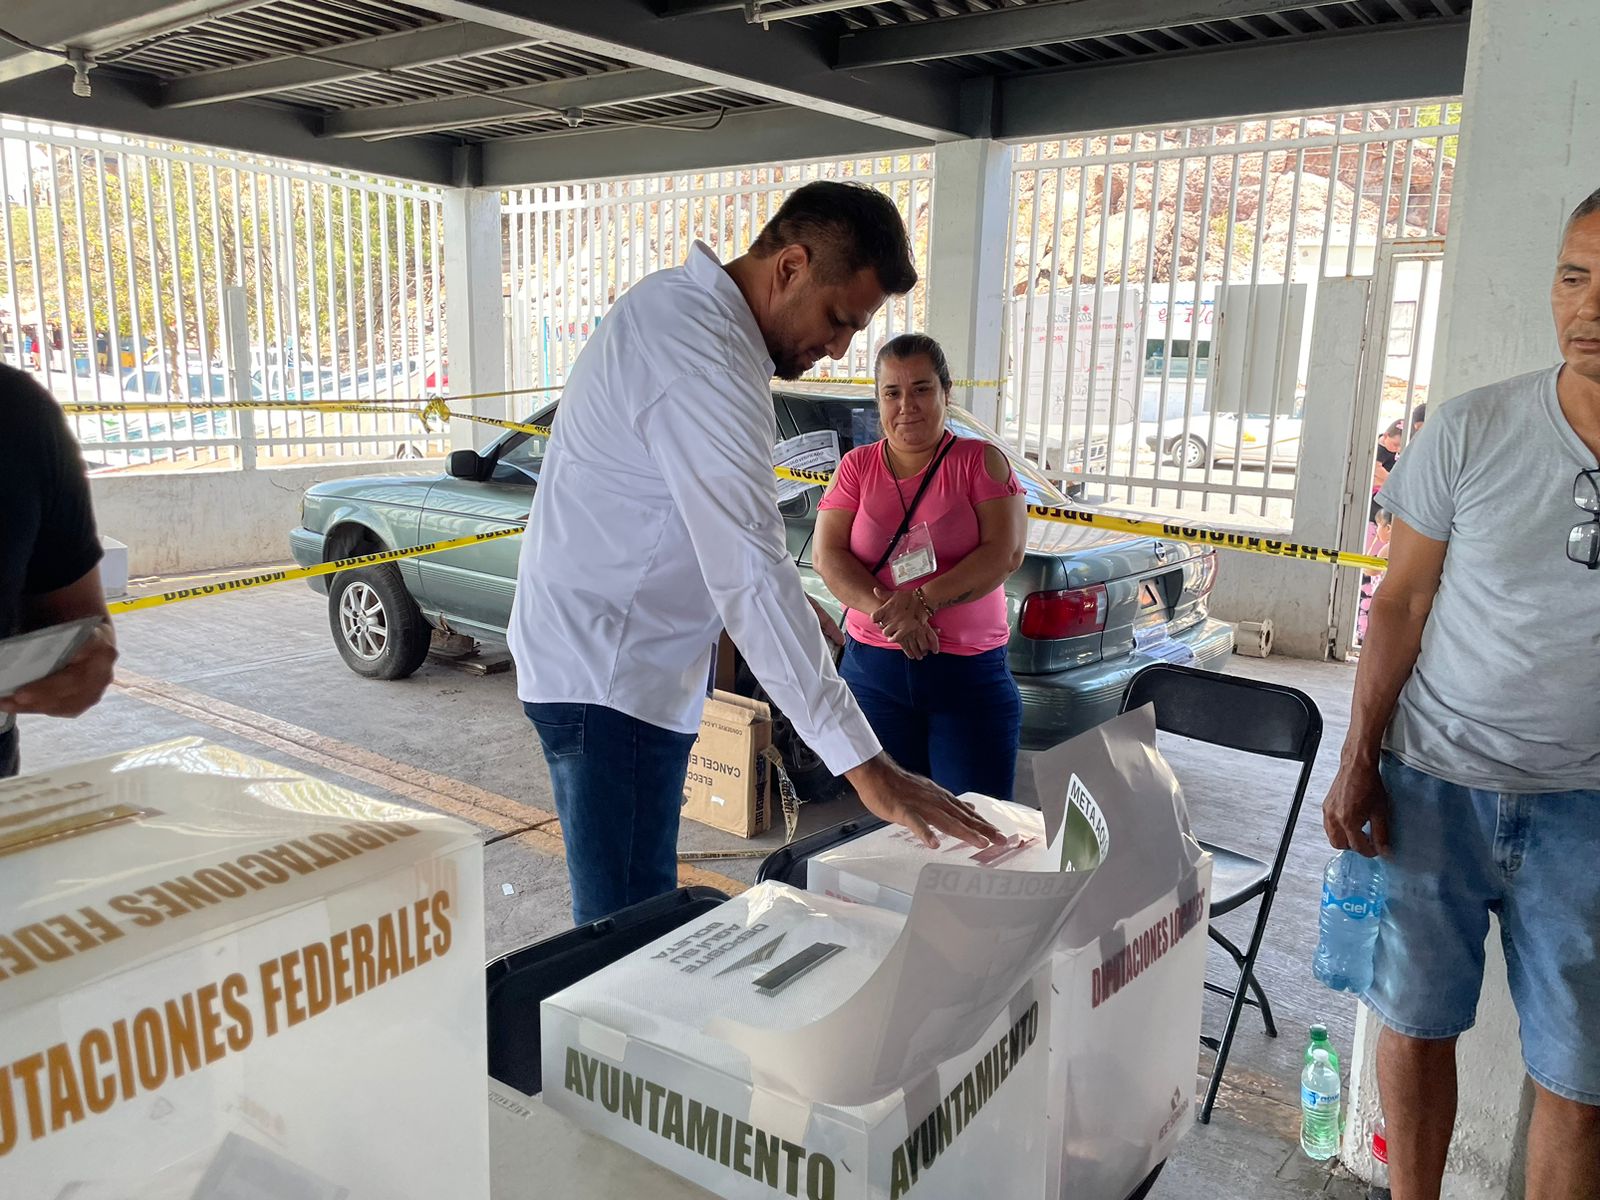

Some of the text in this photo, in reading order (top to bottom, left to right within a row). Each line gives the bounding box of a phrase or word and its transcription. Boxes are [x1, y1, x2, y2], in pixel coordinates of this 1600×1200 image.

[702, 757, 741, 779] CANCEL
[1070, 781, 1096, 826] META
[0, 821, 421, 986] DIPUTACIONES FEDE
[1342, 901, 1368, 914] ciel
[259, 888, 453, 1037] FEDERALES
[650, 921, 725, 960] BOLETA
[669, 947, 702, 965] SU
[680, 922, 769, 974] DEPOSITE
[1091, 887, 1206, 1009] DIPUTACIONES LOCALES
[563, 1045, 837, 1200] AYUNTAMIENTO
[890, 999, 1040, 1200] AYUNTAMIENTO
